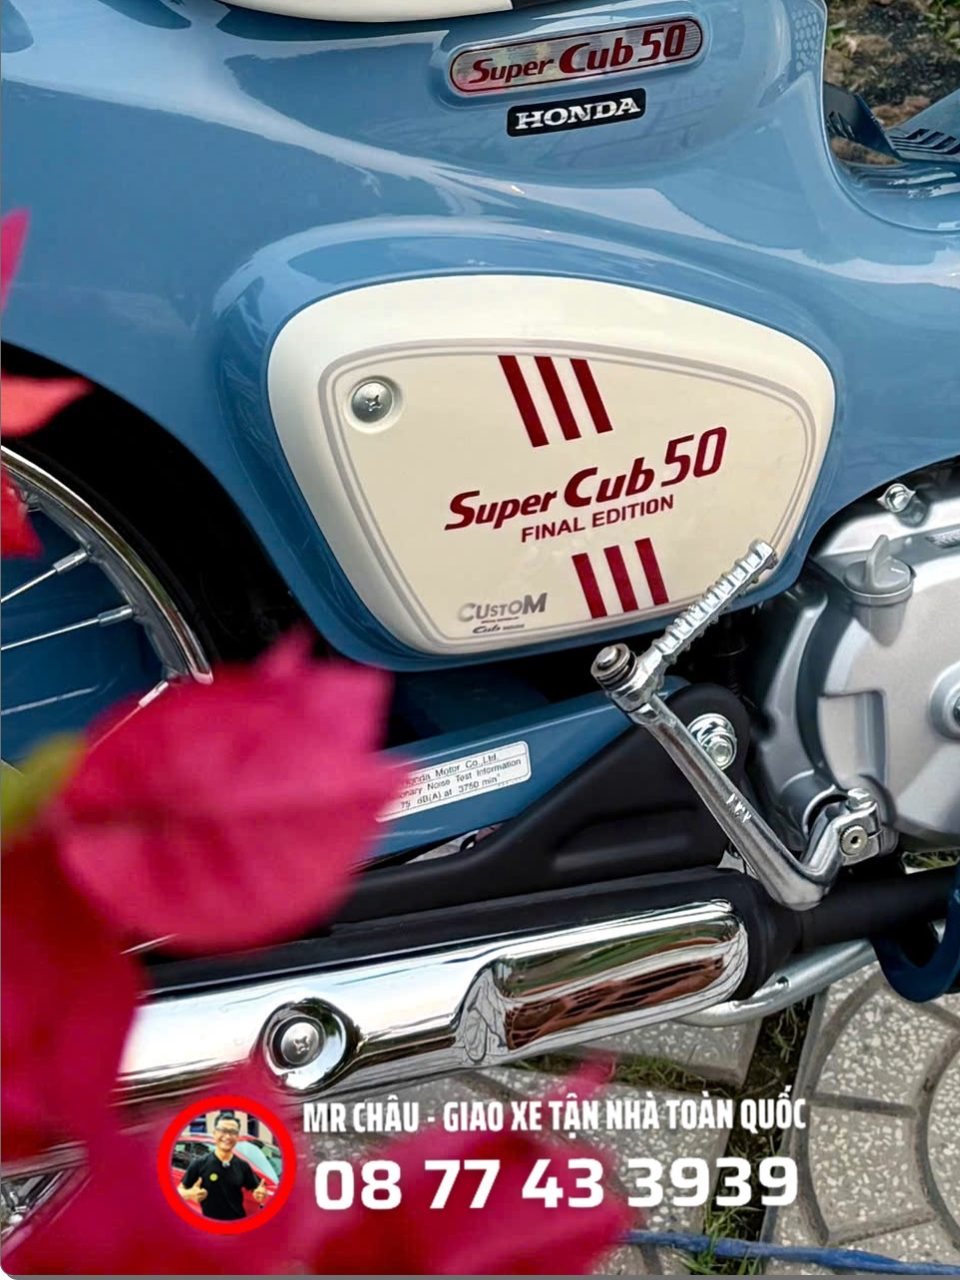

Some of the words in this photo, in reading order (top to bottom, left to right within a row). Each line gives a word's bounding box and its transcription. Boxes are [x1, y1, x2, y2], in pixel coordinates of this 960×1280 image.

[468, 58, 554, 84] Super
[559, 37, 634, 74] Cub
[638, 24, 687, 63] 50
[514, 97, 641, 130] HONDA
[444, 490, 557, 530] Super
[563, 457, 655, 508] Cub
[660, 426, 727, 487] 50
[521, 517, 586, 543] FINAL
[592, 494, 674, 528] EDITION
[427, 779, 451, 791] Noise
[456, 771, 472, 783] Test
[476, 758, 522, 777] Information
[435, 764, 460, 778] Motor
[444, 788, 452, 798] at
